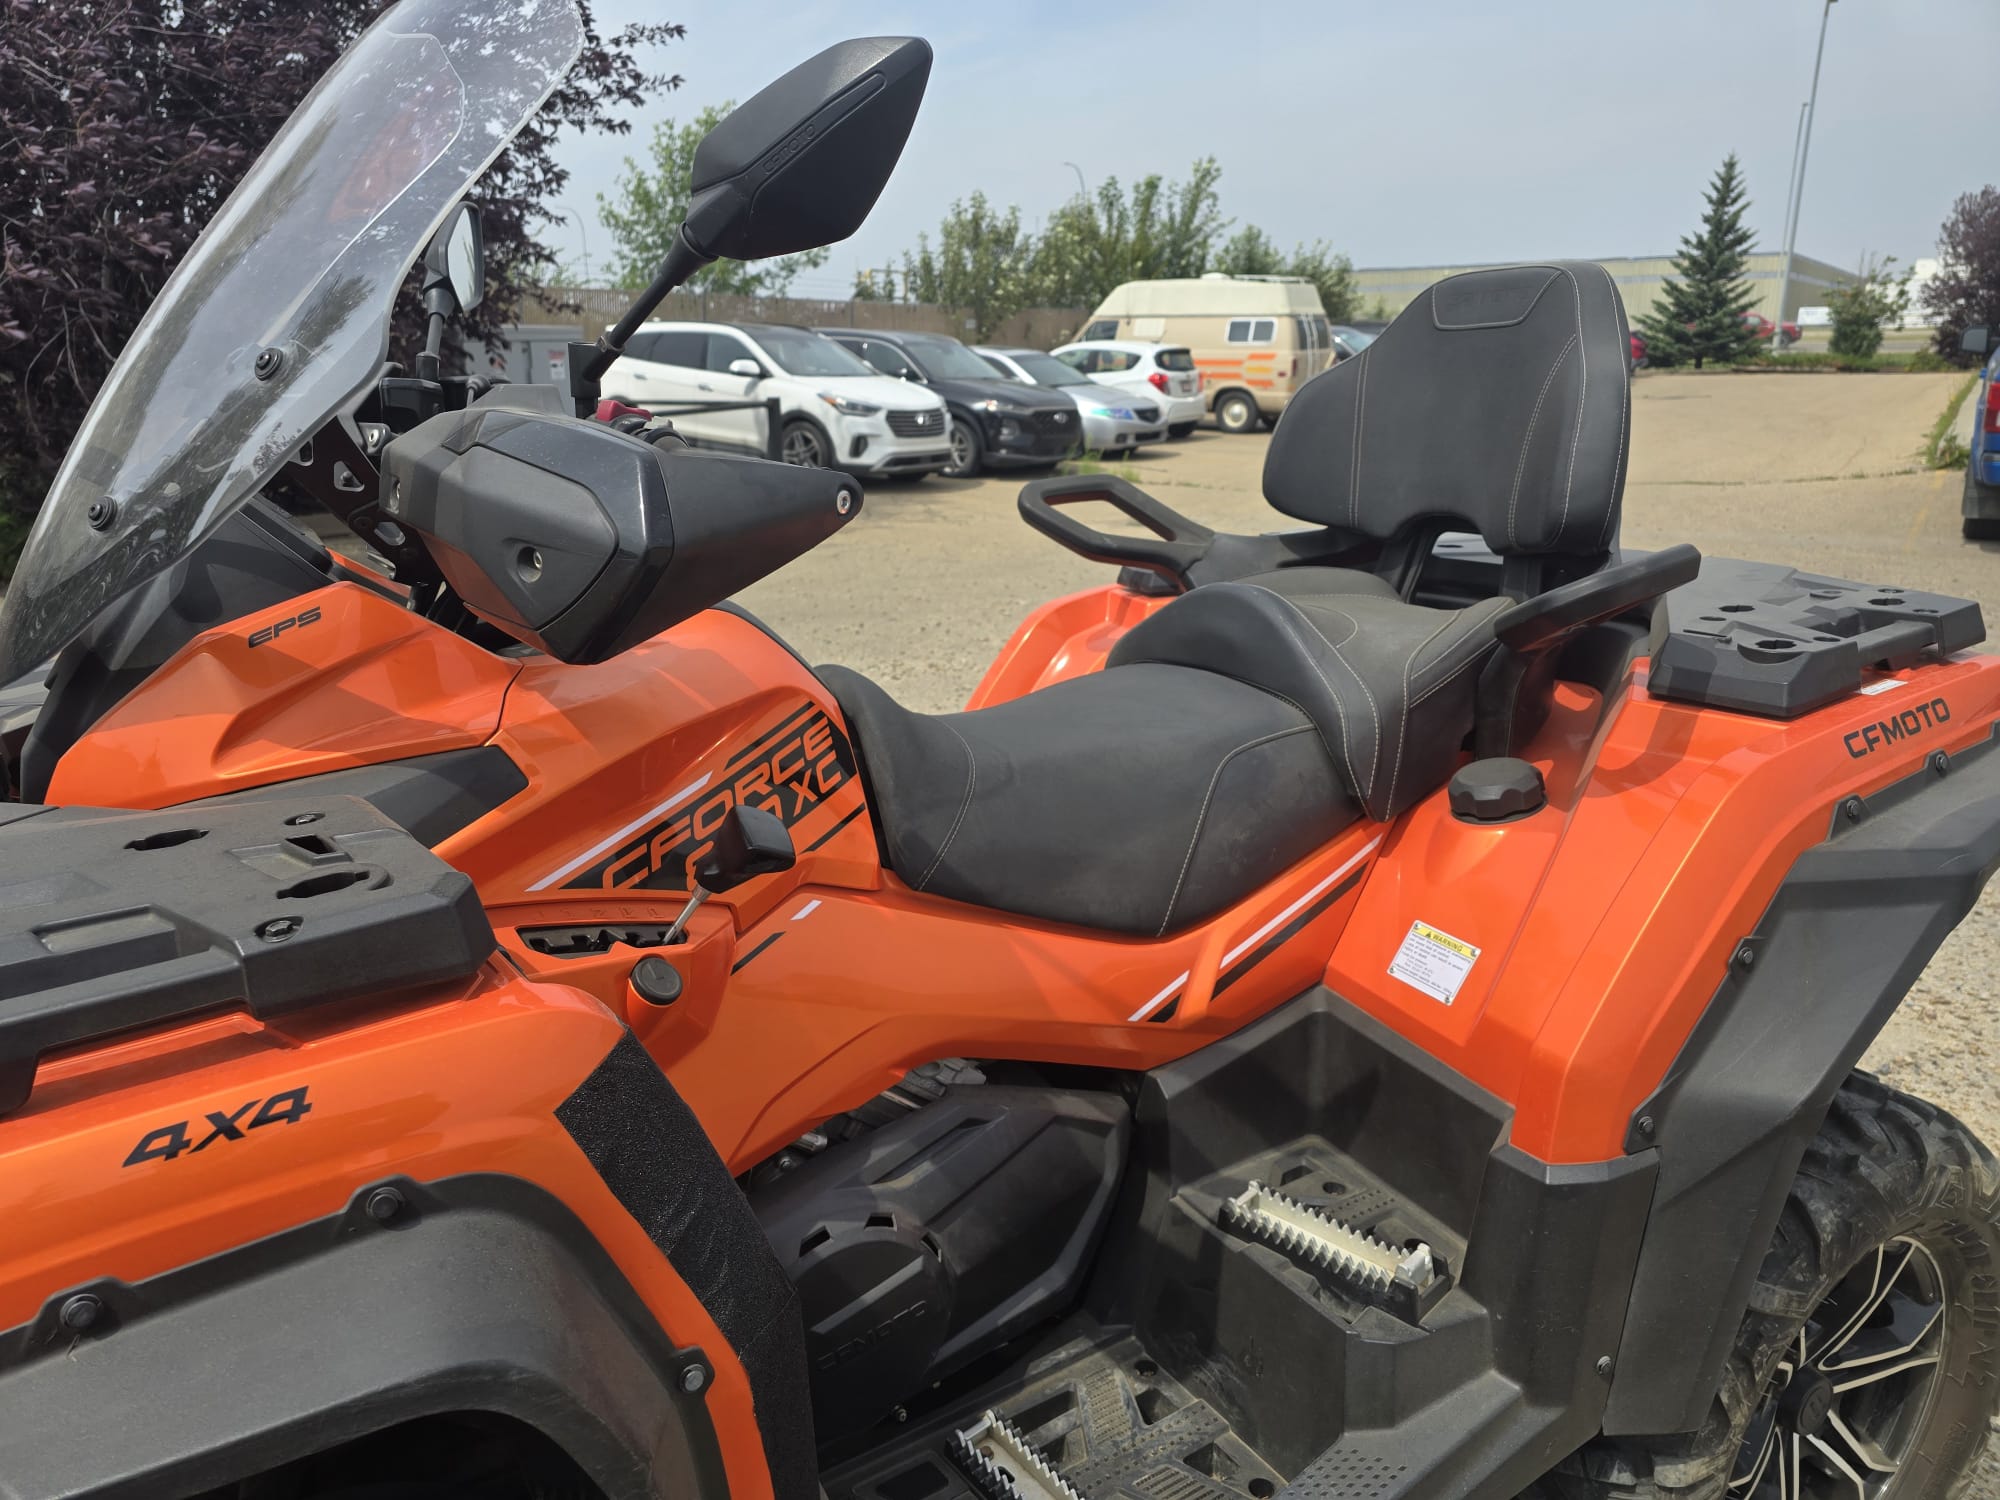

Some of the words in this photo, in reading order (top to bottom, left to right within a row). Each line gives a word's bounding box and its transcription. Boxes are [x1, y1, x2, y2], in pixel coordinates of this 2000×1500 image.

[248, 605, 322, 648] EPS
[1843, 697, 1951, 759] CFMOTO
[602, 716, 833, 889] CFORCE
[792, 749, 843, 816] XC
[1432, 933, 1464, 952] WARNING
